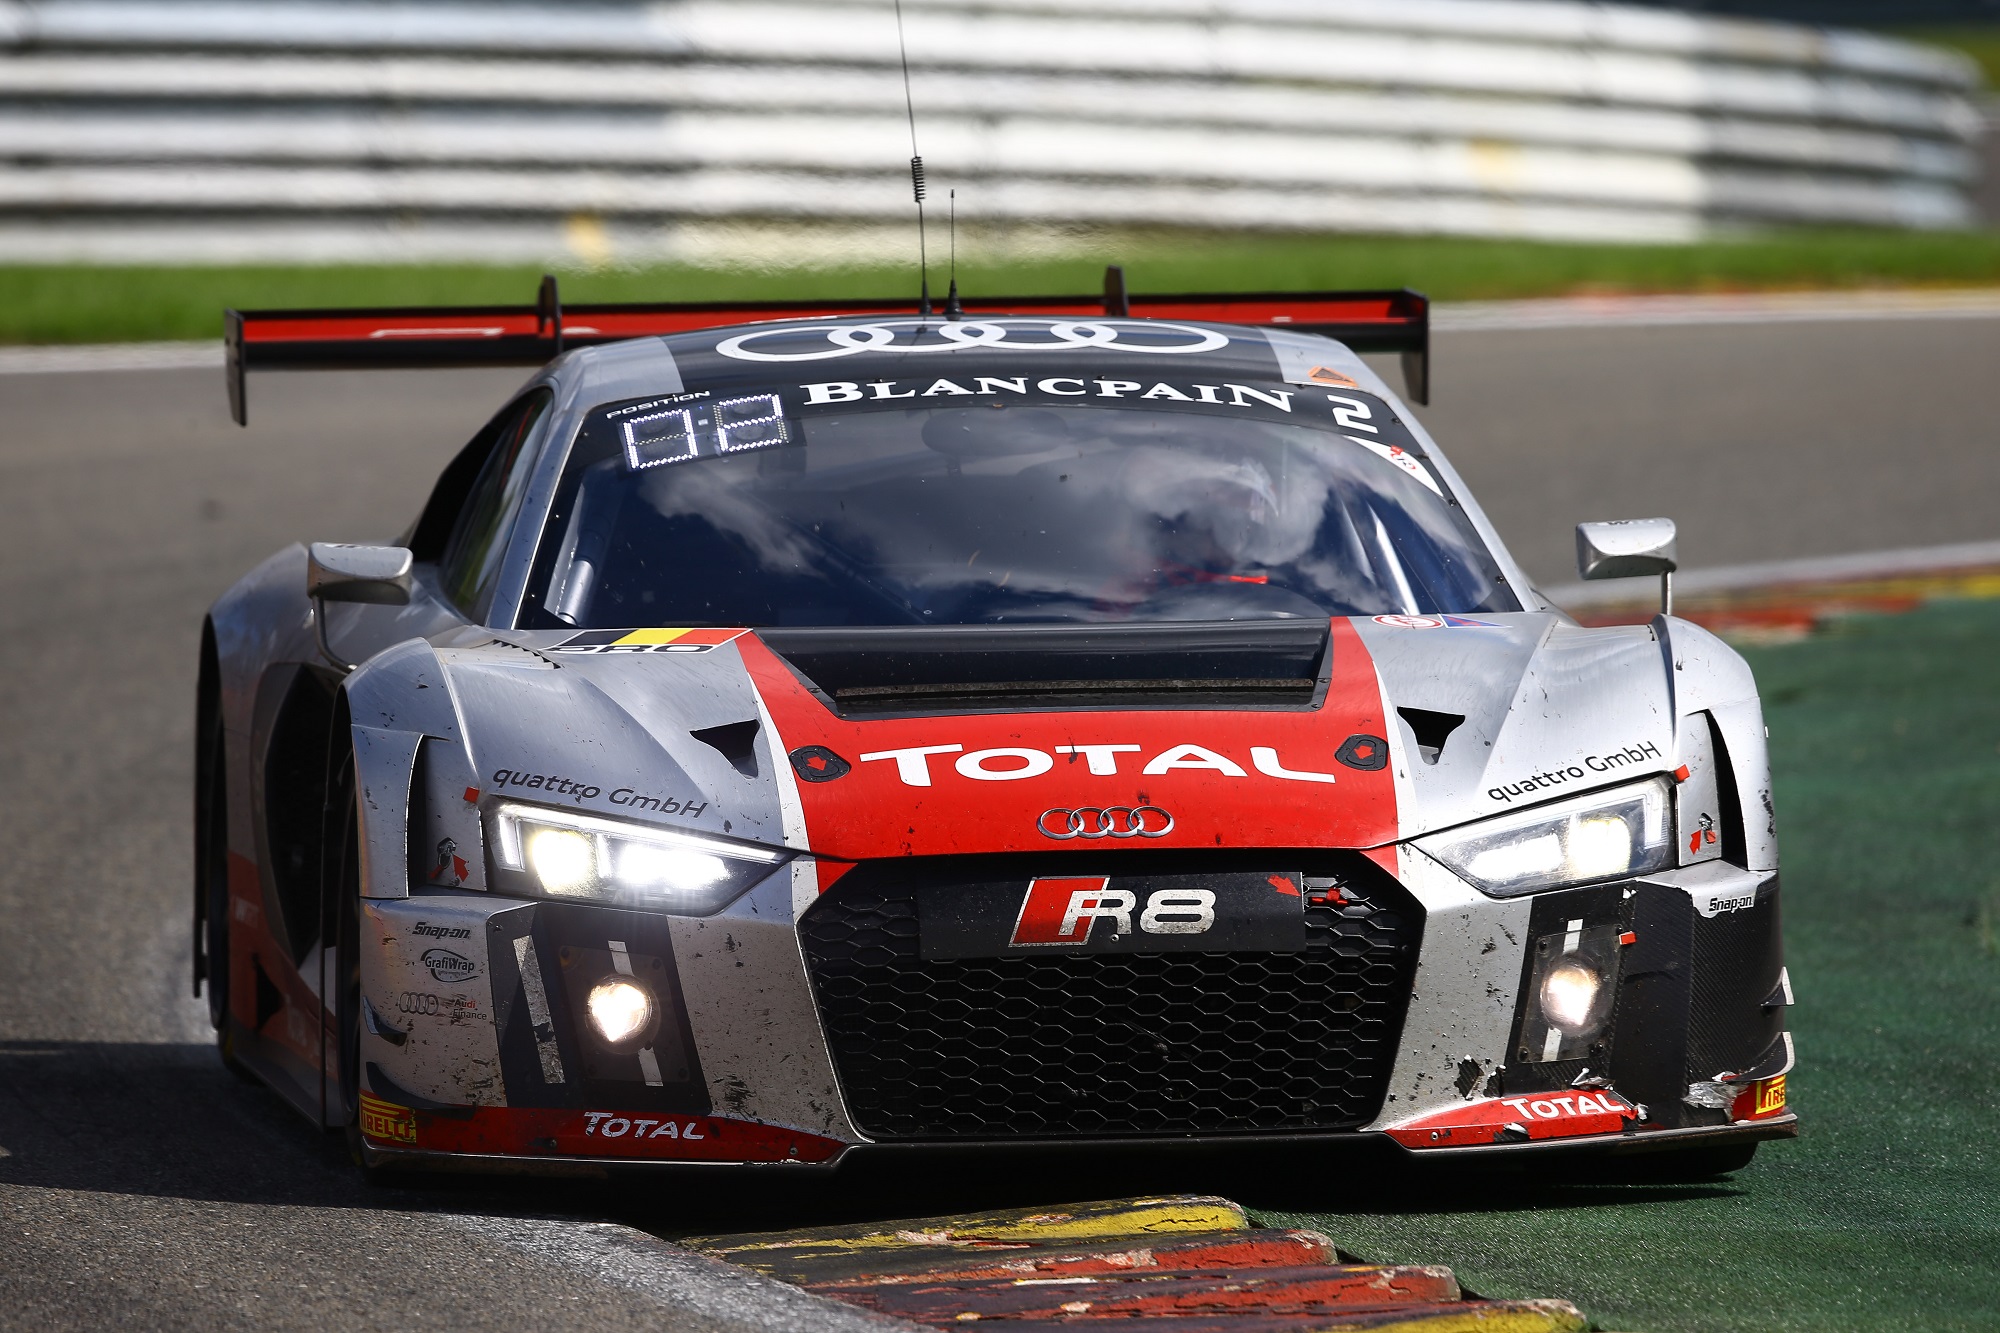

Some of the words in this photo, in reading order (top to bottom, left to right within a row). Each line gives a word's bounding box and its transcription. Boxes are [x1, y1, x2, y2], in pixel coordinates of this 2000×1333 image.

[801, 376, 1294, 413] BLANCPAIN
[1327, 394, 1379, 434] 2
[859, 743, 1336, 787] TOTAL
[1487, 766, 1584, 802] quattro
[1584, 741, 1662, 772] GmbH
[492, 768, 600, 799] quattro
[608, 788, 708, 818] GmbH
[1057, 888, 1217, 935] R8
[1708, 896, 1753, 913] Snap-on
[412, 921, 471, 939] Snap-on
[425, 956, 475, 973] GrafiWrap
[452, 1008, 487, 1020] Finance
[453, 999, 476, 1009] Audi
[1503, 1090, 1626, 1120] TOTAL
[583, 1111, 705, 1140] TOTAL
